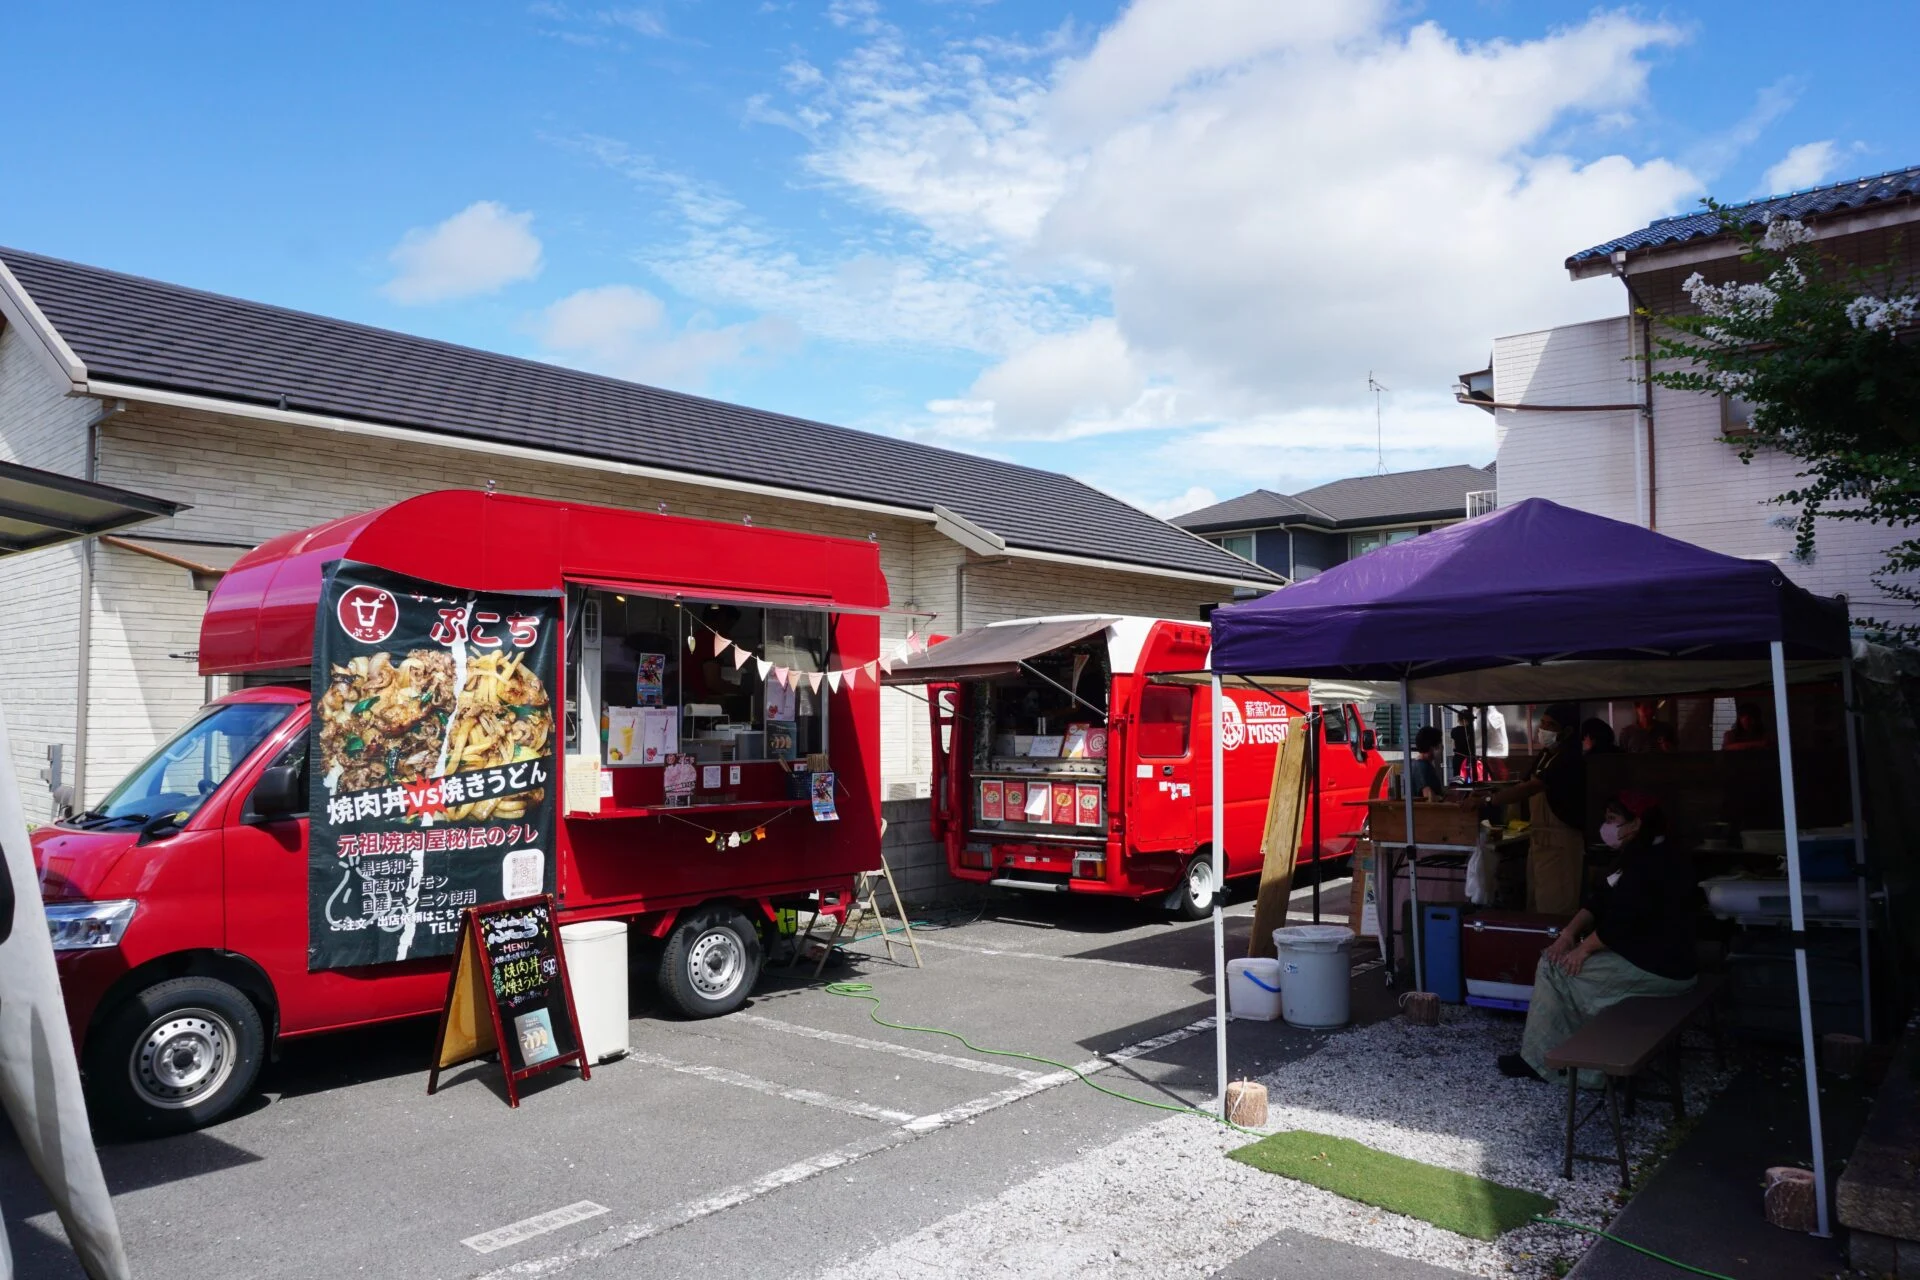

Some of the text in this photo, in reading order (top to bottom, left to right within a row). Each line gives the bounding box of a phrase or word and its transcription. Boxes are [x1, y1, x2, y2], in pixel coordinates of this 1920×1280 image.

[352, 627, 385, 639] ぷこち
[430, 607, 540, 648] ぷこち
[337, 823, 538, 858] 元祖焼肉屋秘伝のタレ
[361, 859, 420, 876] 黒毛和牛
[362, 876, 449, 896] 国産ホルモン
[362, 889, 477, 915] 国産ニンニク使用
[429, 922, 461, 934] TEL:
[504, 956, 541, 980] 焼肉丼
[504, 974, 548, 996] 焼きうどん
